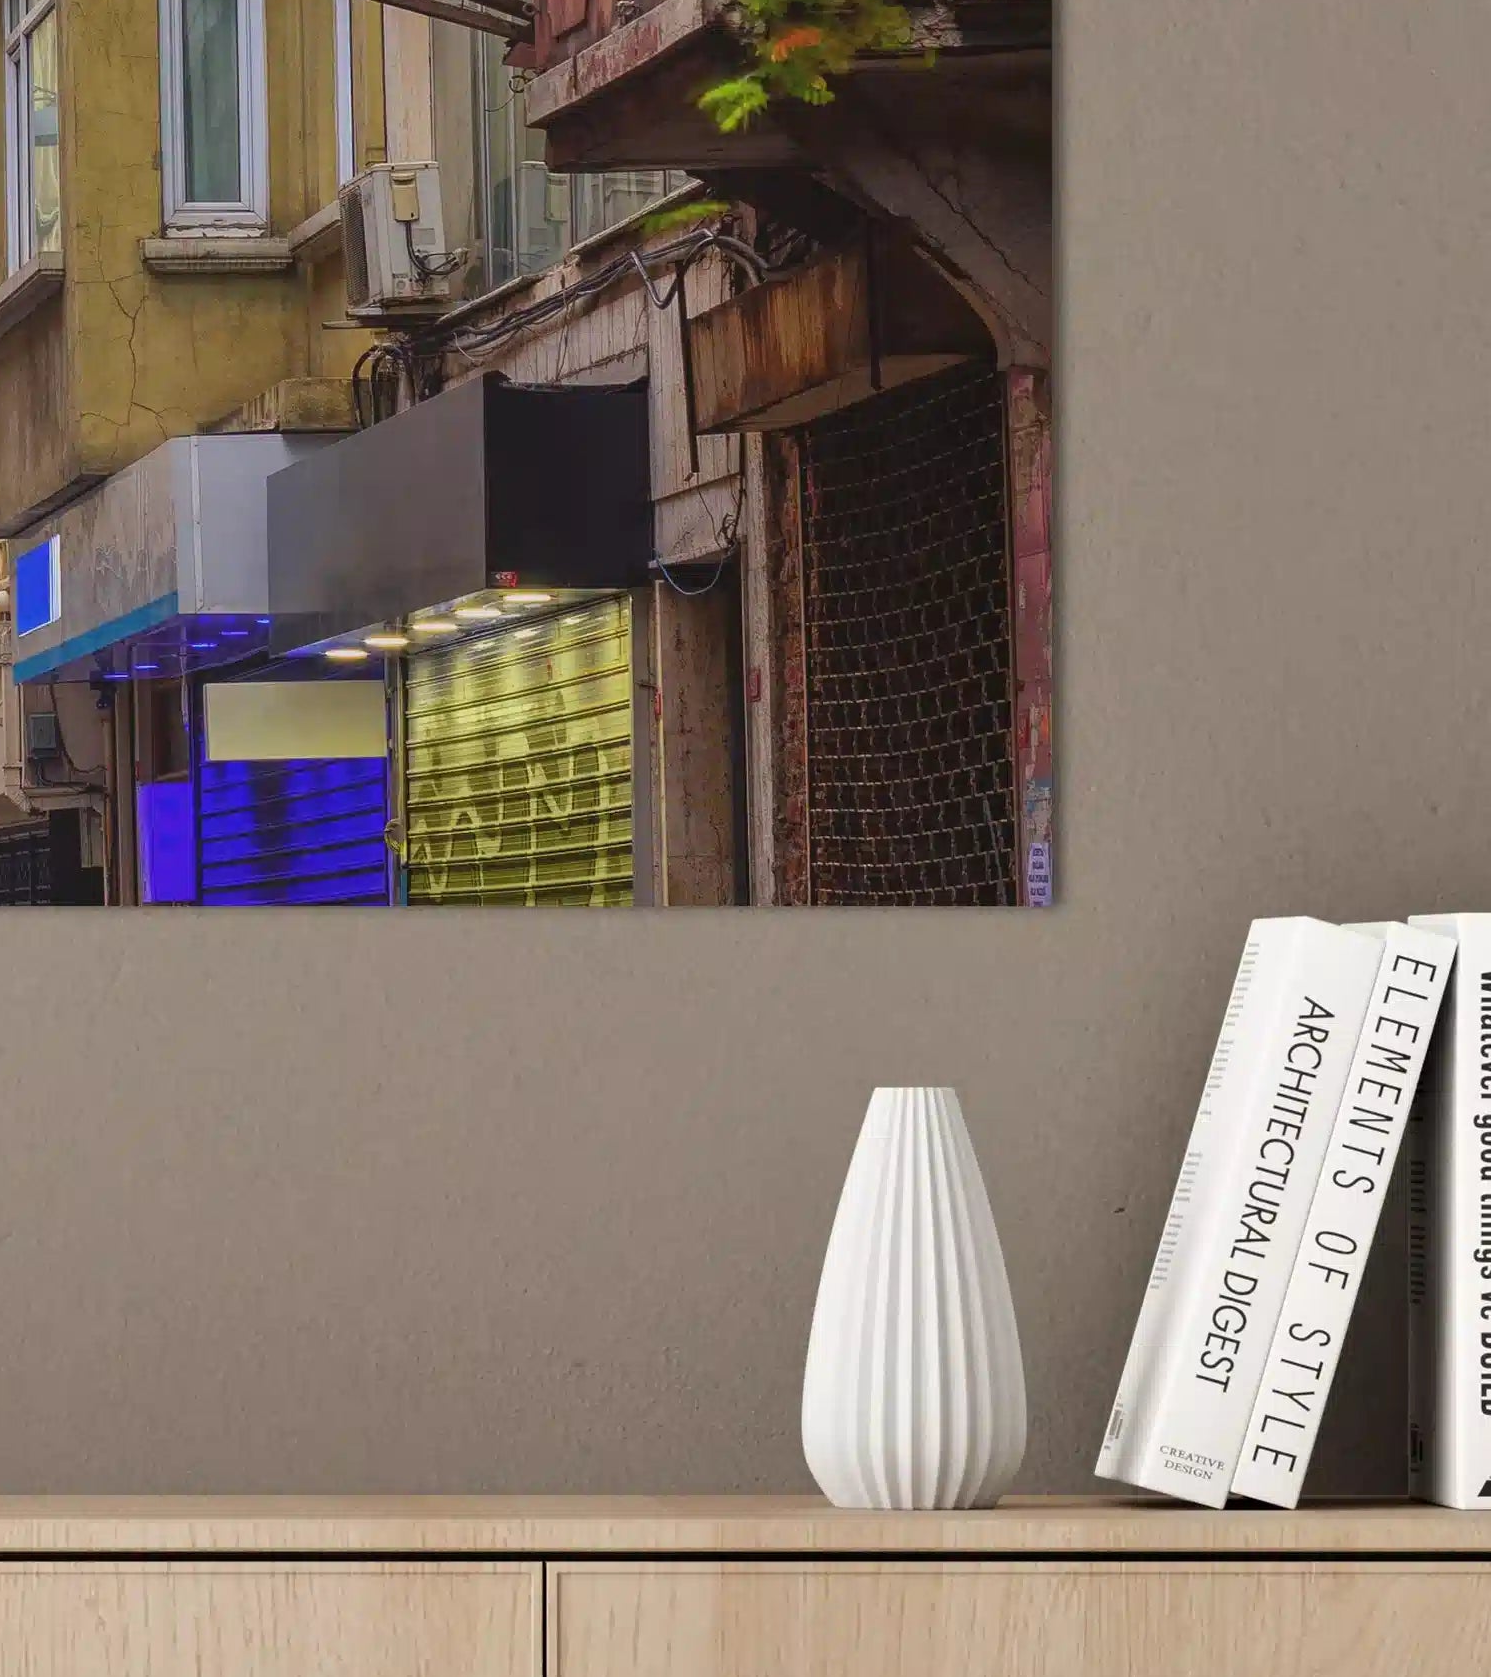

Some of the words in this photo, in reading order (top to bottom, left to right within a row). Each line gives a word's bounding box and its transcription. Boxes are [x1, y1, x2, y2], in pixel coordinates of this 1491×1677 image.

[1230, 995, 1336, 1259] ARCHITECTURAL
[1332, 954, 1437, 1194] ELEMENTS
[1308, 1230, 1358, 1290] OF
[1195, 1270, 1259, 1393] DIGEST
[1159, 1445, 1225, 1471] CREATIVE
[1252, 1322, 1331, 1473] STYLE
[1164, 1459, 1214, 1480] DESIGN
